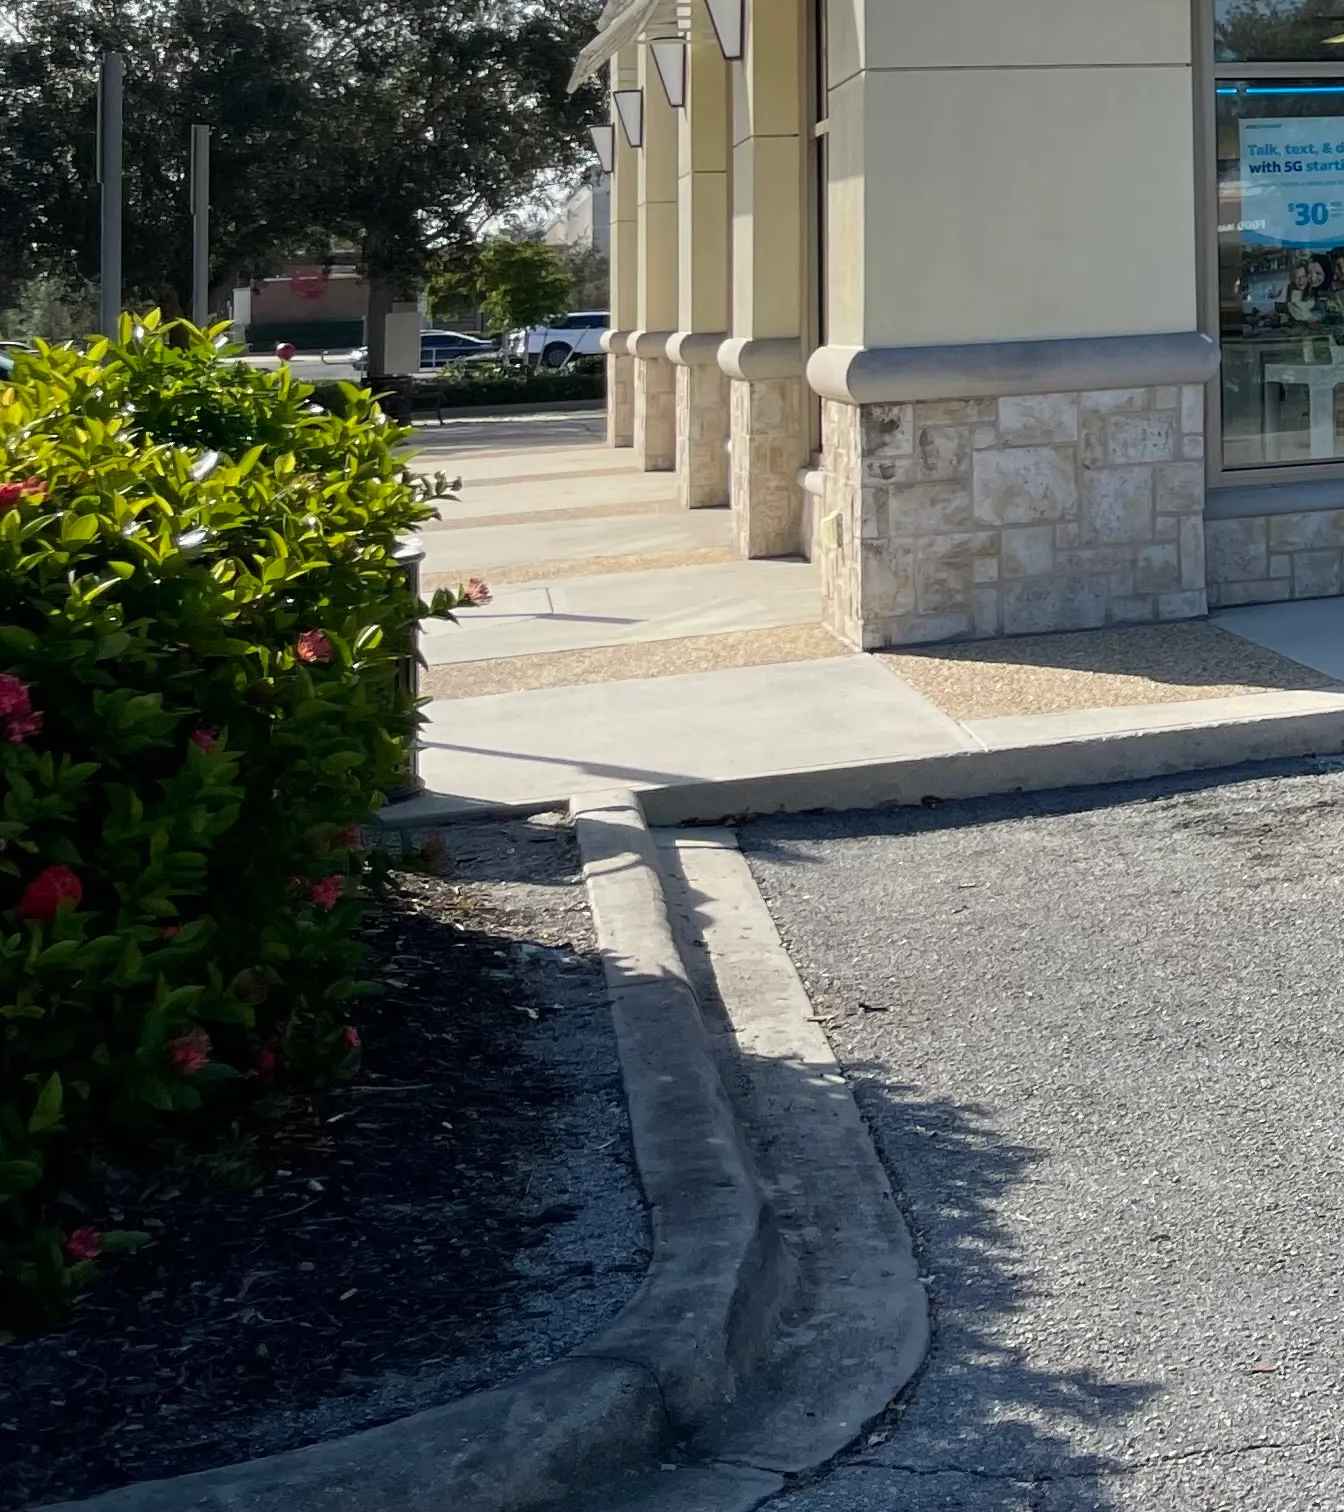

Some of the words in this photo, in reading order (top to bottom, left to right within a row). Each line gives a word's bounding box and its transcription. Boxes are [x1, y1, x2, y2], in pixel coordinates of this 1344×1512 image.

[1247, 143, 1282, 158] Talk,
[1285, 143, 1319, 157] text,
[1322, 141, 1333, 154] &
[1248, 160, 1282, 174] with
[1283, 160, 1303, 173] 5G
[1287, 201, 1329, 227] $30
